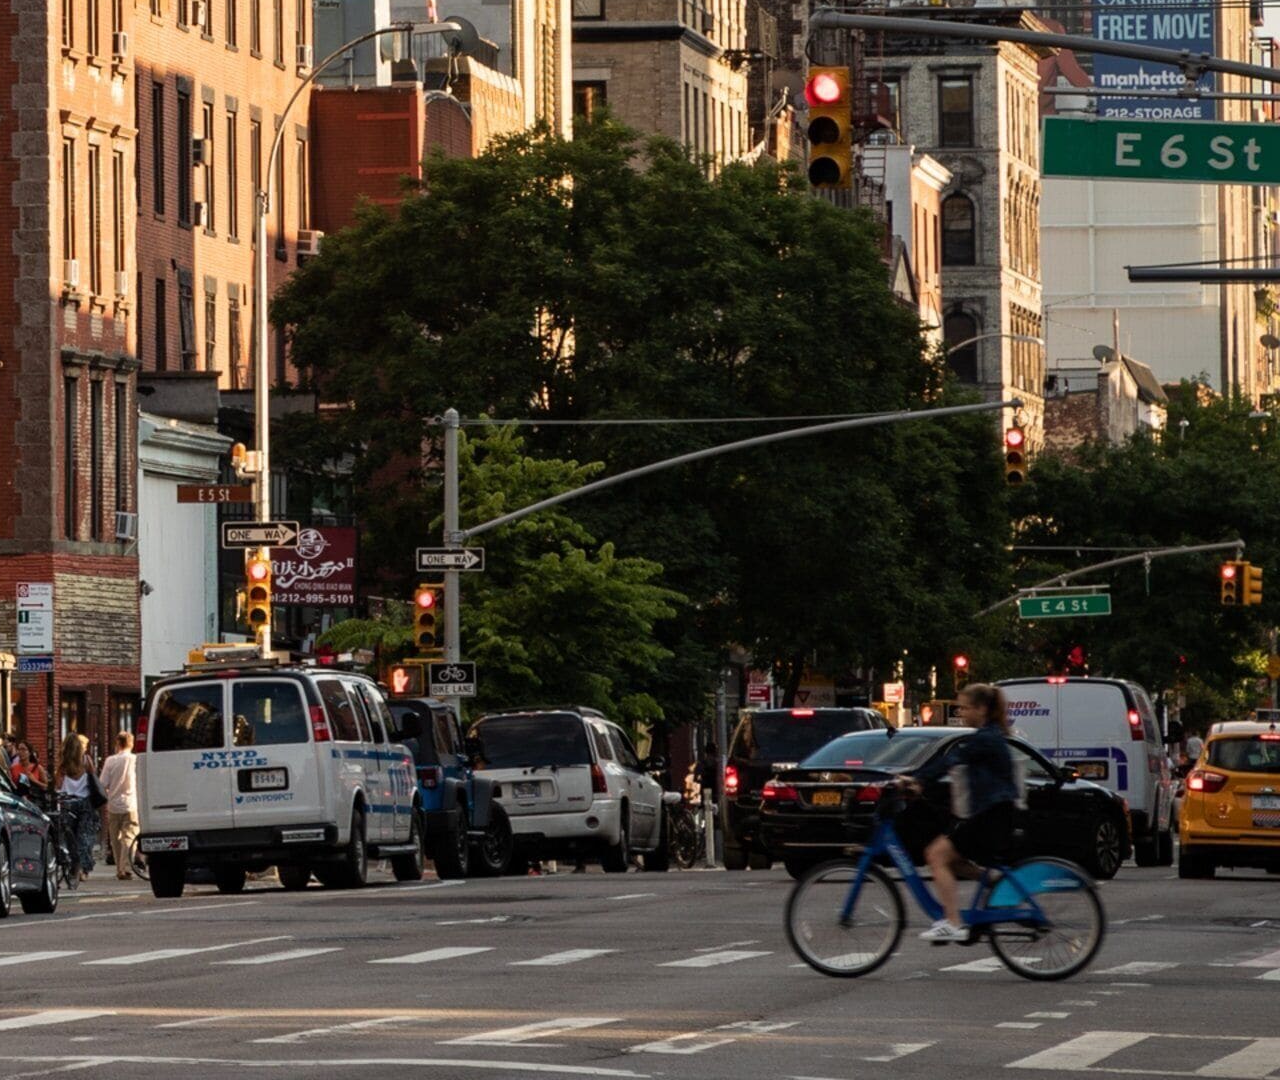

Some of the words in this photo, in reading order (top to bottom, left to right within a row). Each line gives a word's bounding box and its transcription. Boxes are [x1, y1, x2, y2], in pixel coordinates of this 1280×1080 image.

[1098, 15, 1148, 40] FREE
[1153, 13, 1210, 39] MOVE
[1101, 69, 1188, 86] manhatta
[1106, 107, 1201, 118] 212-STORAGE
[1116, 132, 1141, 166] E
[1160, 134, 1188, 169] 6
[1207, 135, 1262, 171] St
[198, 489, 204, 501] E
[208, 489, 215, 501] 5
[219, 489, 230, 501] St
[229, 530, 251, 540] ONE
[264, 530, 288, 539] WAY
[427, 556, 446, 564] ONE
[454, 555, 473, 564] WAY
[271, 594, 354, 604] el:212-995-5101
[1042, 601, 1050, 613] E
[1056, 601, 1065, 611] 4
[1072, 600, 1088, 611] St
[201, 750, 258, 761] NYPD
[193, 758, 268, 770] POLICE
